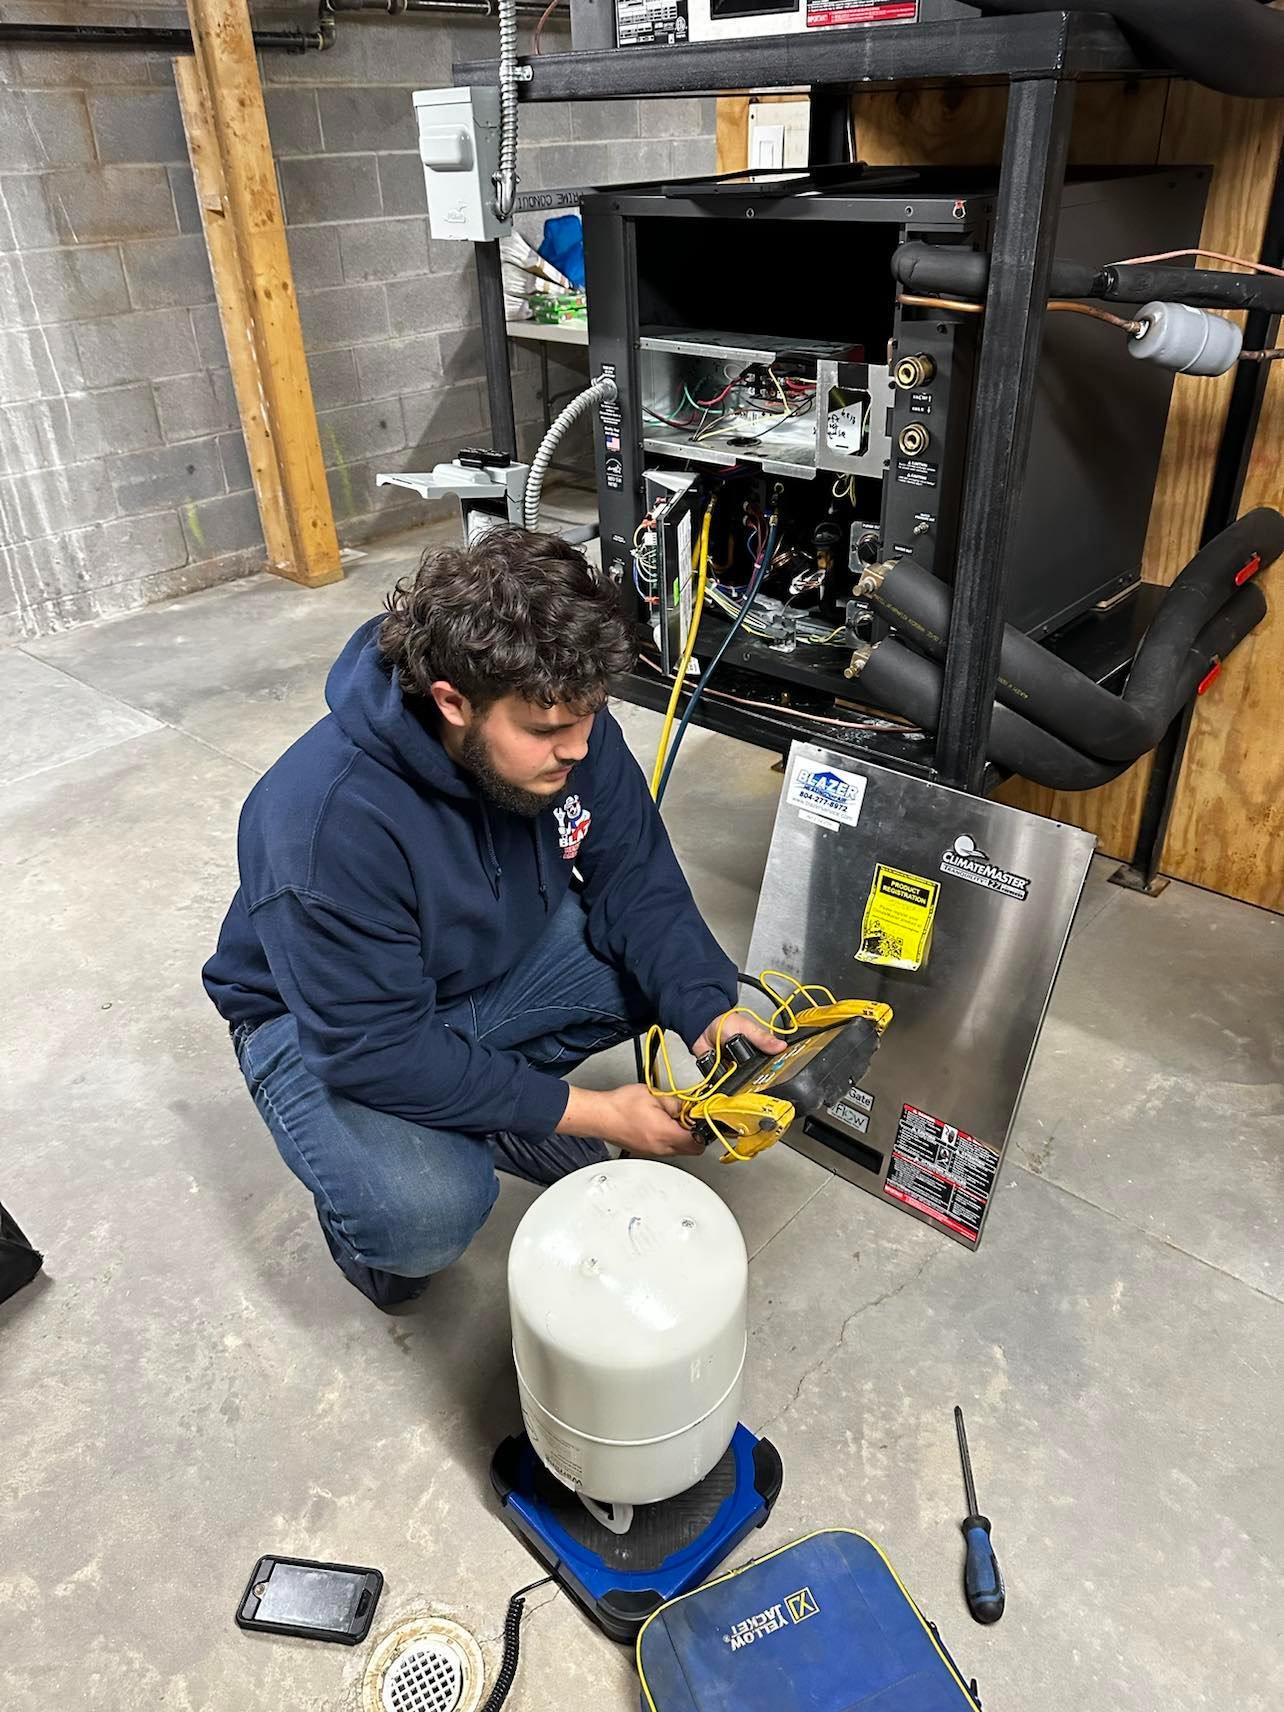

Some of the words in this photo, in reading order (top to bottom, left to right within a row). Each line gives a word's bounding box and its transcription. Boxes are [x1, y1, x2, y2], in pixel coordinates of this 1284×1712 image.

[518, 195, 552, 210] CONDUI
[797, 769, 858, 800] BLAZER
[890, 880, 921, 895] PRODUCT
[988, 879, 1000, 890] 27
[882, 885, 926, 905] REGISTRATION
[849, 1089, 871, 1106] Gate
[730, 1603, 782, 1636] JACKET
[730, 1616, 789, 1651] YELLOW
